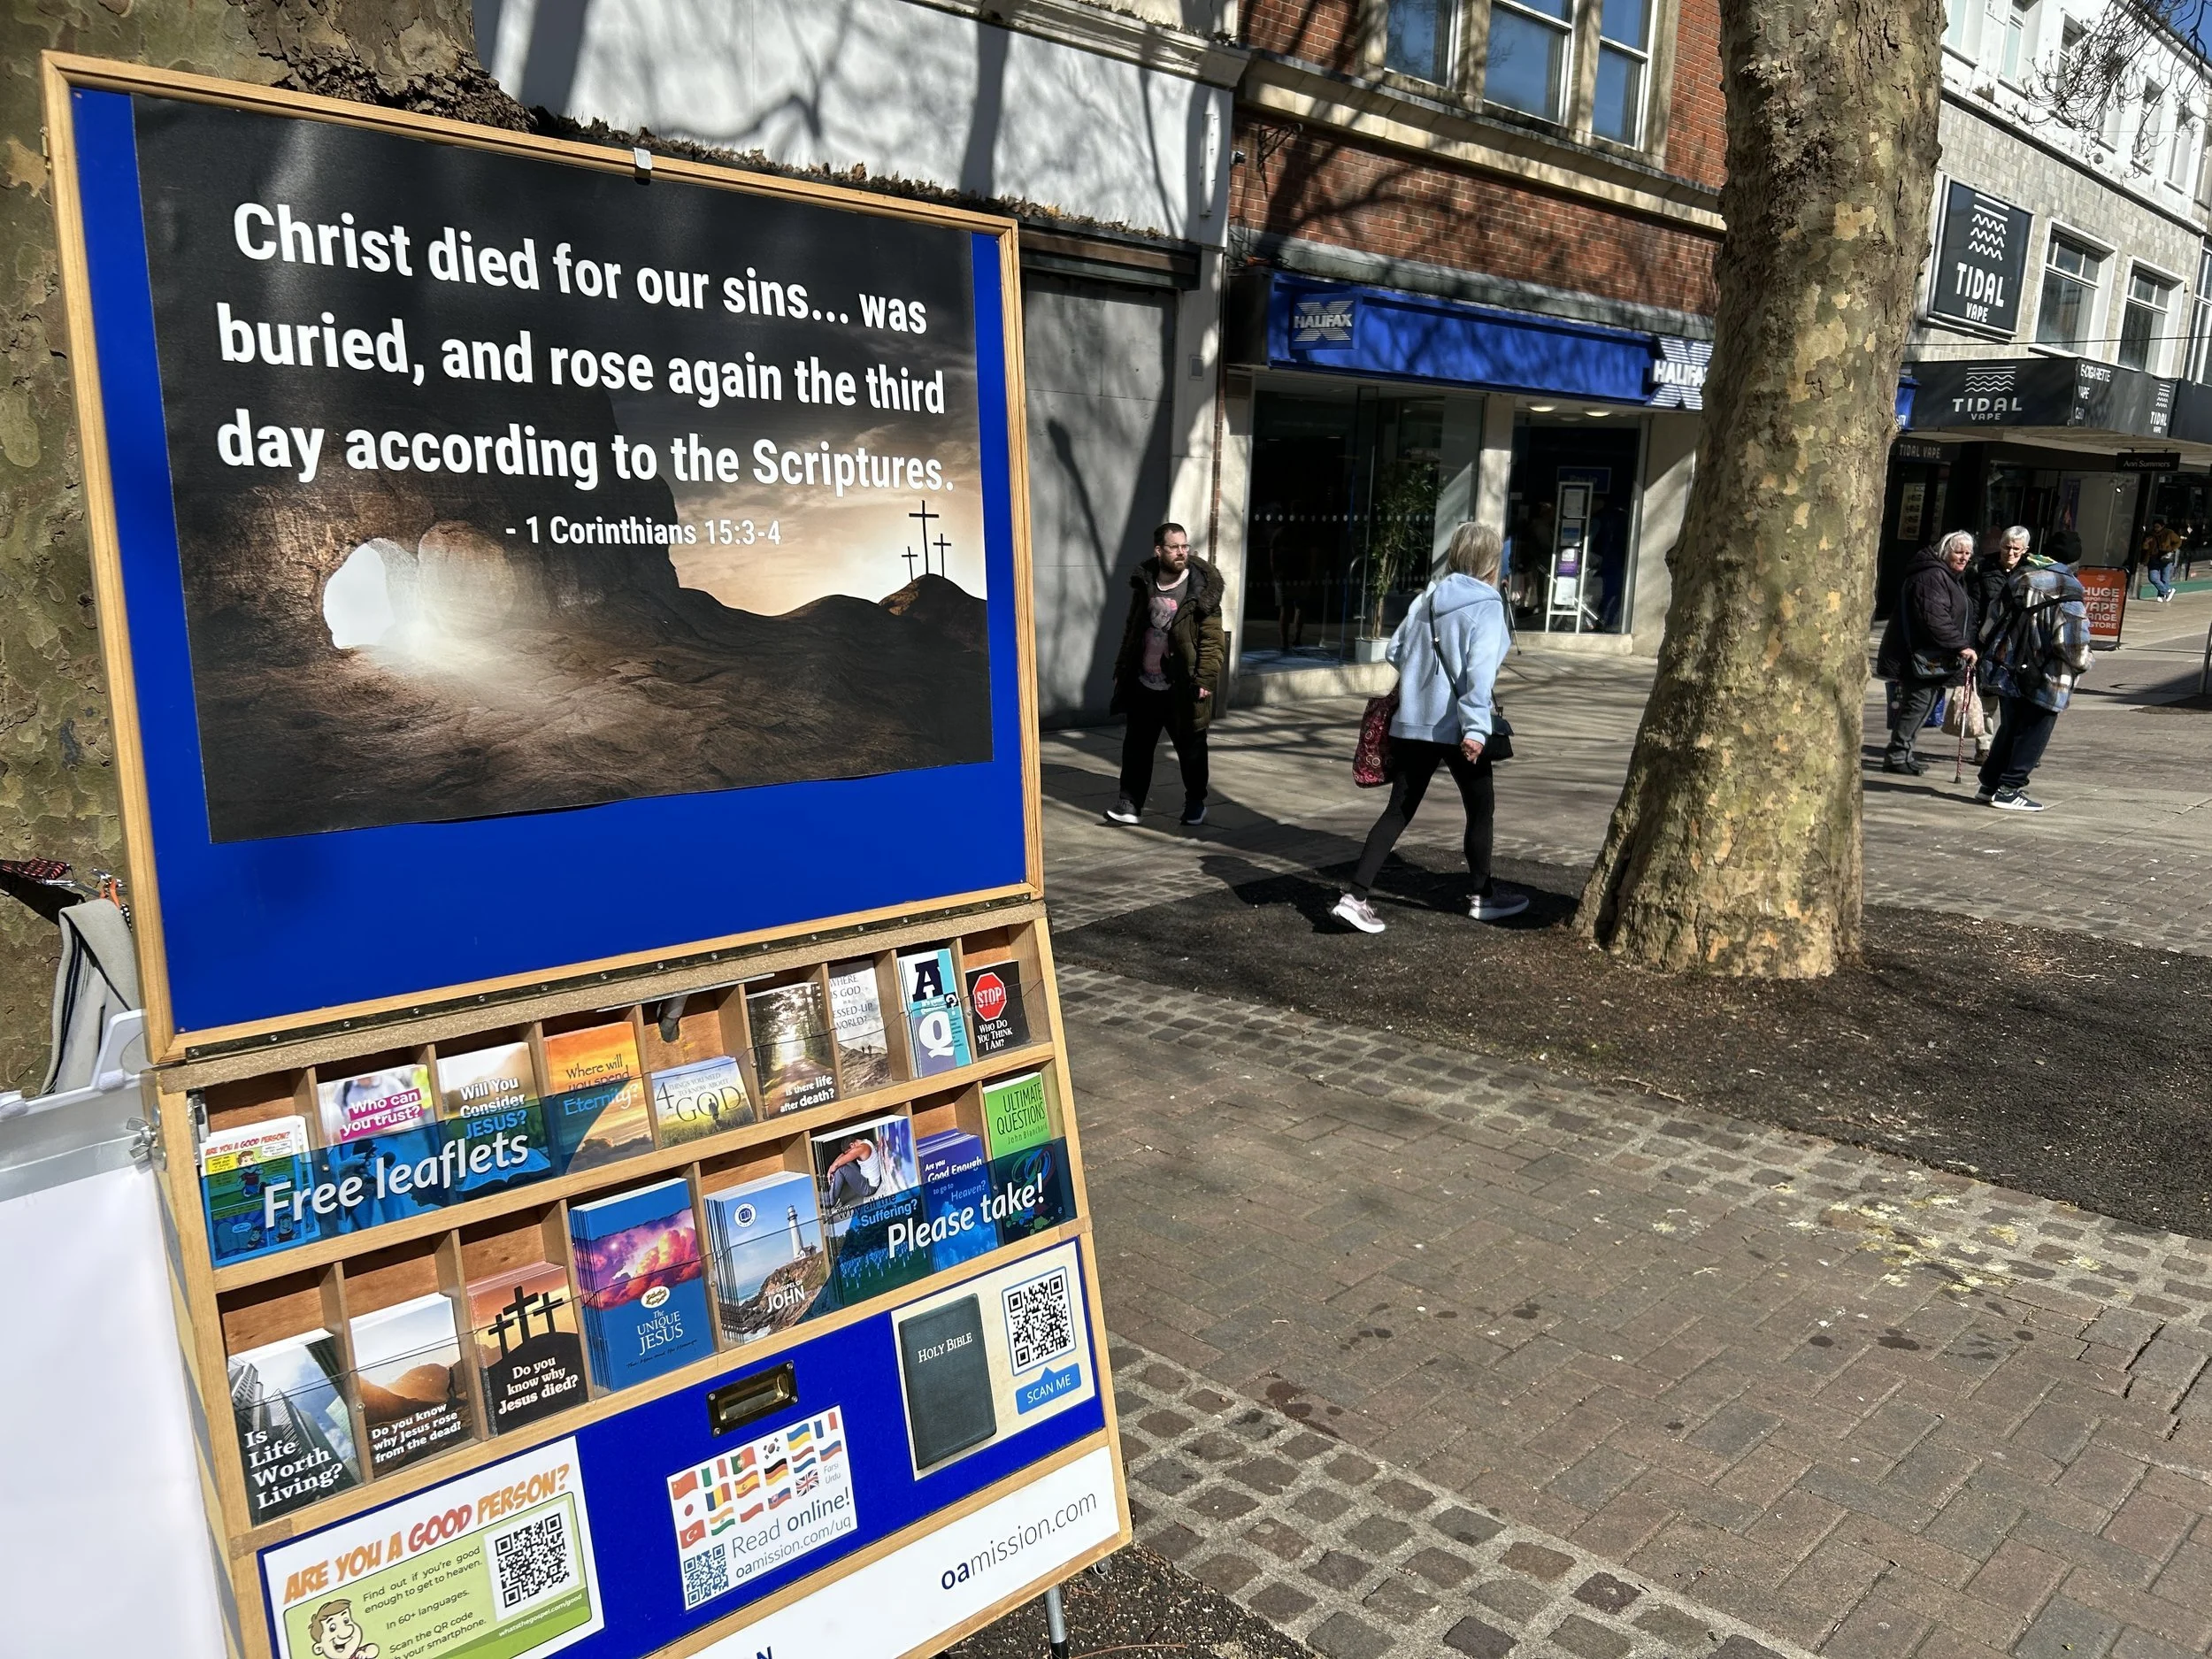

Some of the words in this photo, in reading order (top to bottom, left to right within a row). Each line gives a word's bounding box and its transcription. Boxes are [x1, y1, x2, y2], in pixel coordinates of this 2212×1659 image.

[233, 202, 412, 279] Christ
[428, 226, 541, 292] died
[552, 242, 623, 299] for
[635, 264, 709, 311] our
[722, 268, 850, 326] sins...
[859, 292, 928, 334] was
[1956, 262, 2005, 308] TIDAL
[1294, 312, 1353, 329] HALIFAX
[1966, 302, 1988, 323] VAPE
[217, 303, 426, 387] buried,
[442, 331, 534, 384] and
[549, 345, 655, 393] rose
[668, 351, 784, 409] again
[795, 357, 857, 407] the
[866, 364, 946, 415] third
[1953, 397, 2023, 412] TIDAL
[1970, 412, 2001, 421] VAPE
[2150, 411, 2168, 426] TIDAL
[216, 408, 324, 484] day
[345, 423, 599, 491] according
[611, 434, 659, 481] to
[670, 434, 741, 484] the
[752, 438, 956, 497] Scriptures.
[1900, 444, 1920, 458] TIDAL
[1923, 446, 1941, 459] VAPE
[529, 517, 541, 545] 1
[549, 515, 697, 547] Corinthians
[705, 518, 782, 547] 15:3-4
[2083, 587, 2120, 597] HUGE
[2087, 612, 2117, 622] ANGE
[829, 975, 858, 987] WHERE
[840, 986, 861, 998] GOD
[912, 958, 944, 1002] A
[977, 987, 1002, 1009] STOP
[918, 1010, 955, 1058] Q
[566, 1063, 603, 1079] Where
[605, 1054, 623, 1070] will
[568, 1079, 592, 1096] you
[594, 1065, 630, 1092] spend
[668, 1079, 690, 1090] THINGS
[690, 1076, 703, 1086] YOU
[703, 1072, 721, 1083] NEED
[460, 1083, 489, 1102] Will
[490, 1077, 519, 1094] You
[563, 1083, 639, 1116] Eternity?
[656, 1082, 675, 1110] 4
[678, 1088, 687, 1097] TO
[687, 1084, 707, 1095] KNOW
[708, 1078, 730, 1090] ABOUT
[794, 1082, 815, 1094] there
[815, 1075, 833, 1087] life
[1002, 1082, 1043, 1113] ULTIMATE
[350, 1099, 388, 1115] Who
[390, 1091, 419, 1106] can
[459, 1093, 526, 1119] Consider
[676, 1086, 742, 1122] GOD
[780, 1101, 799, 1113] after
[799, 1087, 835, 1107] death?
[342, 1118, 371, 1137] you
[374, 1106, 420, 1126] trust?
[465, 1110, 528, 1141] JESUS?
[996, 1102, 1046, 1136] QUESTIONS
[1008, 1133, 1023, 1145] John
[1023, 1123, 1048, 1140] Blanchard
[205, 1146, 219, 1156] ARE
[219, 1143, 234, 1153] YOU
[240, 1136, 260, 1149] GOOD
[260, 1132, 290, 1146] PERSON?
[265, 1174, 364, 1229] Free
[376, 1131, 530, 1201] leaflets
[925, 1163, 935, 1172] Are
[934, 1159, 946, 1170] you
[927, 1170, 949, 1184] Good
[951, 1156, 983, 1175] Enough
[864, 1198, 877, 1211] all
[878, 1194, 897, 1208] the
[940, 1187, 948, 1195] go
[950, 1179, 987, 1202] Heaven?
[860, 1198, 918, 1227] Suffering?
[887, 1205, 975, 1258] Please
[979, 1172, 1044, 1225] take!
[767, 1286, 806, 1314] JOHN
[776, 1281, 795, 1293] GOSPEL
[636, 1310, 681, 1337] UNIQUE
[653, 1309, 664, 1318] The
[639, 1322, 684, 1356] JESUS
[918, 1343, 945, 1363] HOLY
[947, 1332, 973, 1352] BIBLE
[507, 1376, 540, 1396] know
[542, 1366, 566, 1386] why
[512, 1363, 532, 1379] Do
[534, 1356, 557, 1375] you
[498, 1391, 538, 1416] Jesus
[541, 1375, 579, 1401] died?
[1026, 1383, 1055, 1404] SCAN
[1056, 1374, 1071, 1392] ME
[372, 1425, 388, 1440] Do
[390, 1416, 413, 1435] you
[416, 1403, 448, 1423] know
[373, 1435, 397, 1453] why
[399, 1424, 430, 1444] Jesus
[433, 1411, 458, 1427] rose
[244, 1430, 268, 1449] Is
[374, 1448, 405, 1464] from
[407, 1439, 427, 1453] the
[429, 1421, 462, 1444] dead?
[249, 1440, 296, 1470] Life
[252, 1447, 332, 1490] Worth
[824, 1462, 840, 1475] Farsi
[256, 1462, 344, 1509] Living?
[825, 1471, 841, 1485] Urdu
[283, 1560, 330, 1605] ARE
[336, 1537, 382, 1582] YOU
[387, 1531, 403, 1563] A
[408, 1503, 472, 1553] GOOD
[476, 1463, 571, 1525] PERSON?
[732, 1519, 781, 1559] Read
[787, 1486, 851, 1532] online!
[735, 1514, 852, 1579] oamission.com/uq
[941, 1492, 1098, 1592] oamission.com
[363, 1586, 386, 1602] Find
[390, 1578, 408, 1591] out
[411, 1571, 420, 1582] if
[422, 1558, 452, 1578] you're
[456, 1546, 481, 1564] good
[365, 1593, 403, 1614] enough
[405, 1588, 416, 1597] to
[417, 1580, 434, 1594] get
[434, 1575, 445, 1585] to
[446, 1560, 483, 1582] heaven.
[386, 1621, 396, 1630] In
[398, 1612, 416, 1624] 60+
[418, 1589, 470, 1617] languages.
[497, 1593, 584, 1638] whatsthegospel.com/good
[389, 1640, 414, 1654] Scan
[415, 1629, 433, 1643] the
[434, 1621, 449, 1634] QR
[449, 1610, 474, 1627] code
[403, 1644, 426, 1659] your
[426, 1617, 488, 1650] smartphone.
